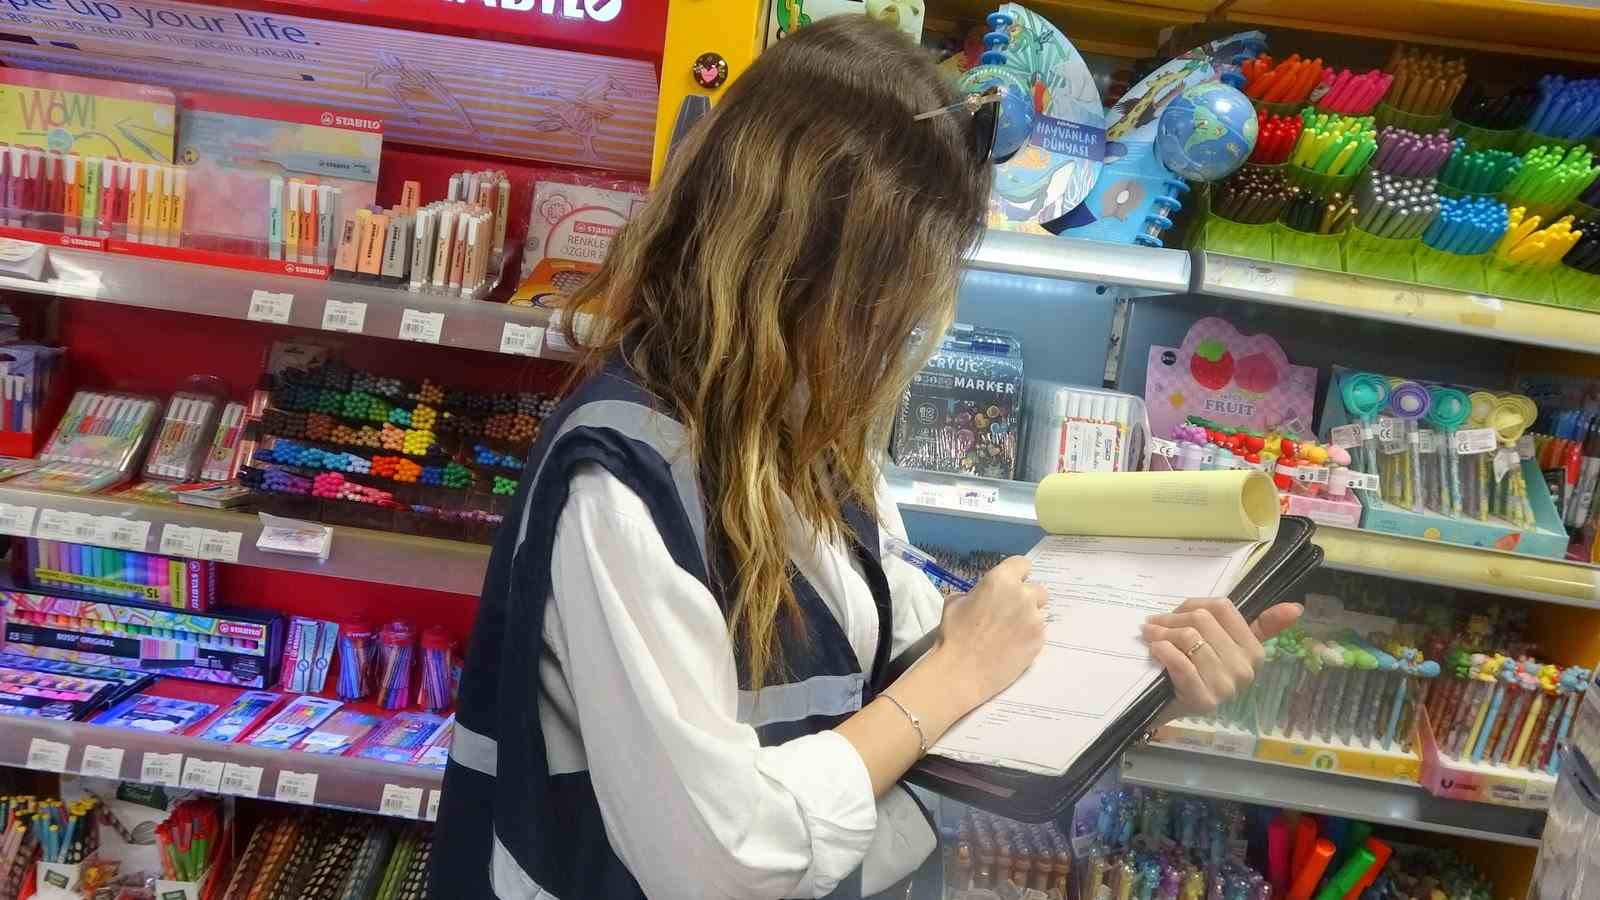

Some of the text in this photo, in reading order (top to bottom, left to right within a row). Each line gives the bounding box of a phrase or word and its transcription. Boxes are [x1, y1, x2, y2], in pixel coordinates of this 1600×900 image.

[129, 6, 225, 33] your
[234, 13, 321, 46] life.
[335, 116, 380, 130] STABILO
[1036, 122, 1098, 145] HAYVANLAR
[954, 376, 1014, 394] MARKER
[1204, 399, 1257, 416] FRUIT
